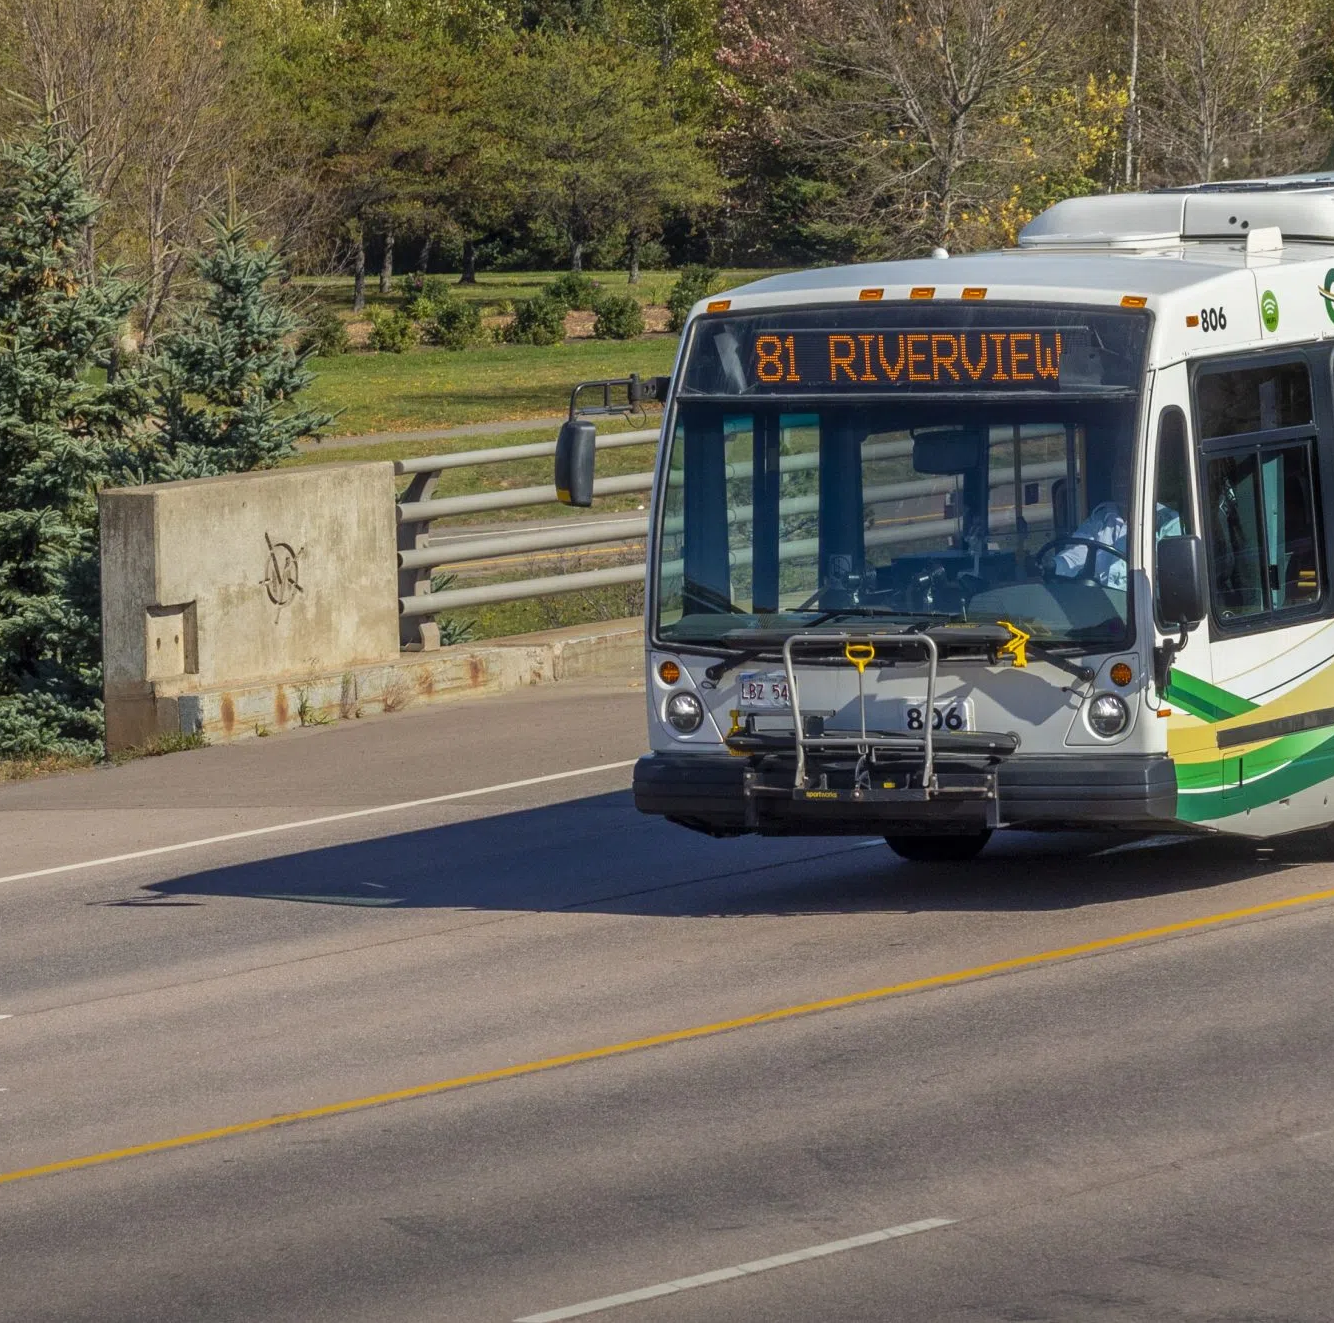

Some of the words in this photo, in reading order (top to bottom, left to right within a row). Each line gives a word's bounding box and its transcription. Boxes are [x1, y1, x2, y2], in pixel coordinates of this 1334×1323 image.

[1200, 306, 1227, 333] 806
[755, 334, 801, 382] 81
[828, 332, 1065, 382] RIVERVIEW
[741, 682, 765, 700] LBZ
[907, 707, 963, 730] 806
